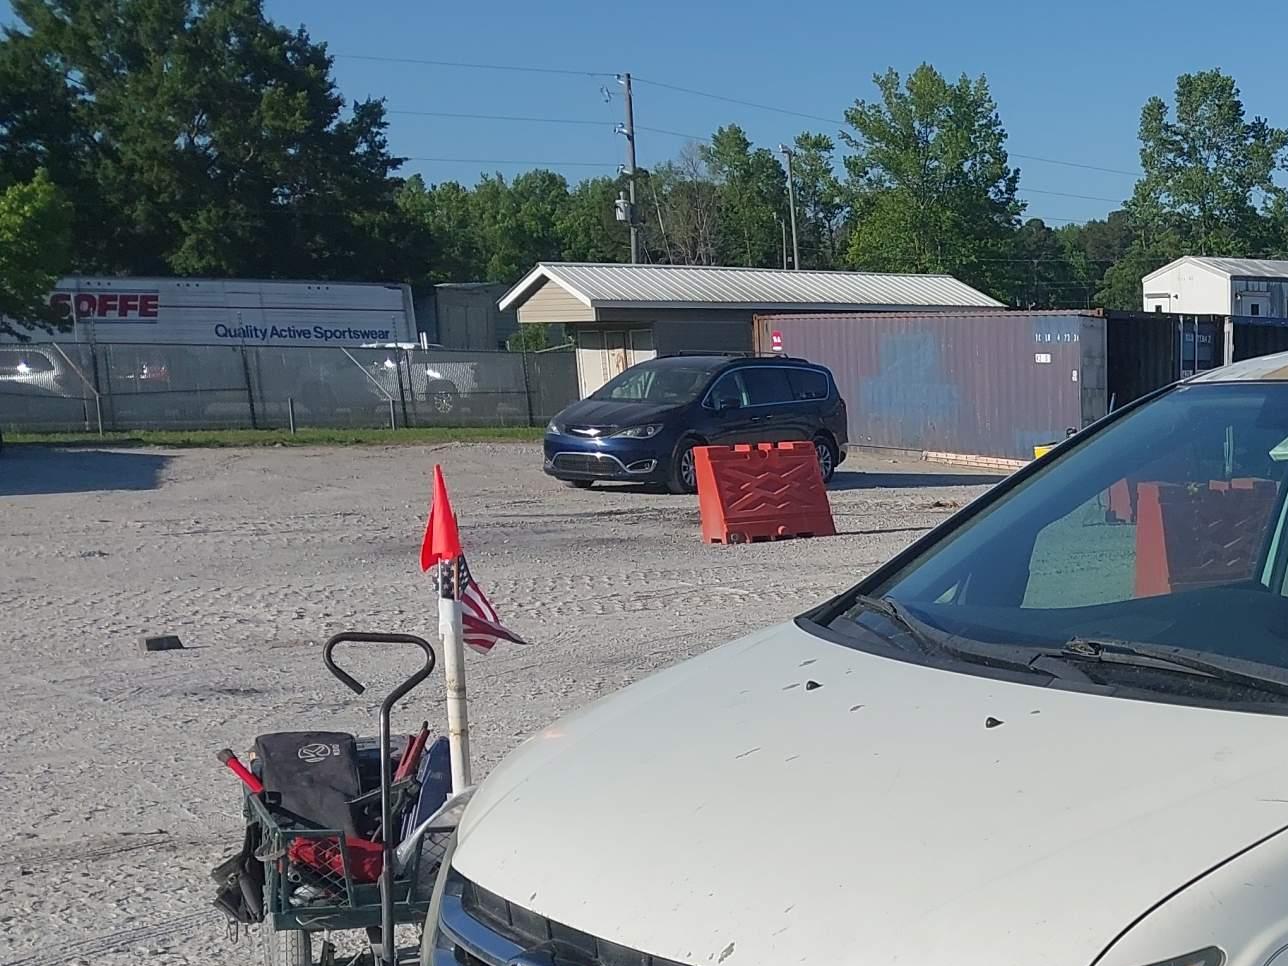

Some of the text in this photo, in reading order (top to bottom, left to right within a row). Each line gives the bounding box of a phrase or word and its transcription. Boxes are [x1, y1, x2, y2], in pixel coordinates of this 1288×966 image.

[50, 293, 159, 318] SOFFE
[214, 323, 391, 342] Quality Active Sportswear
